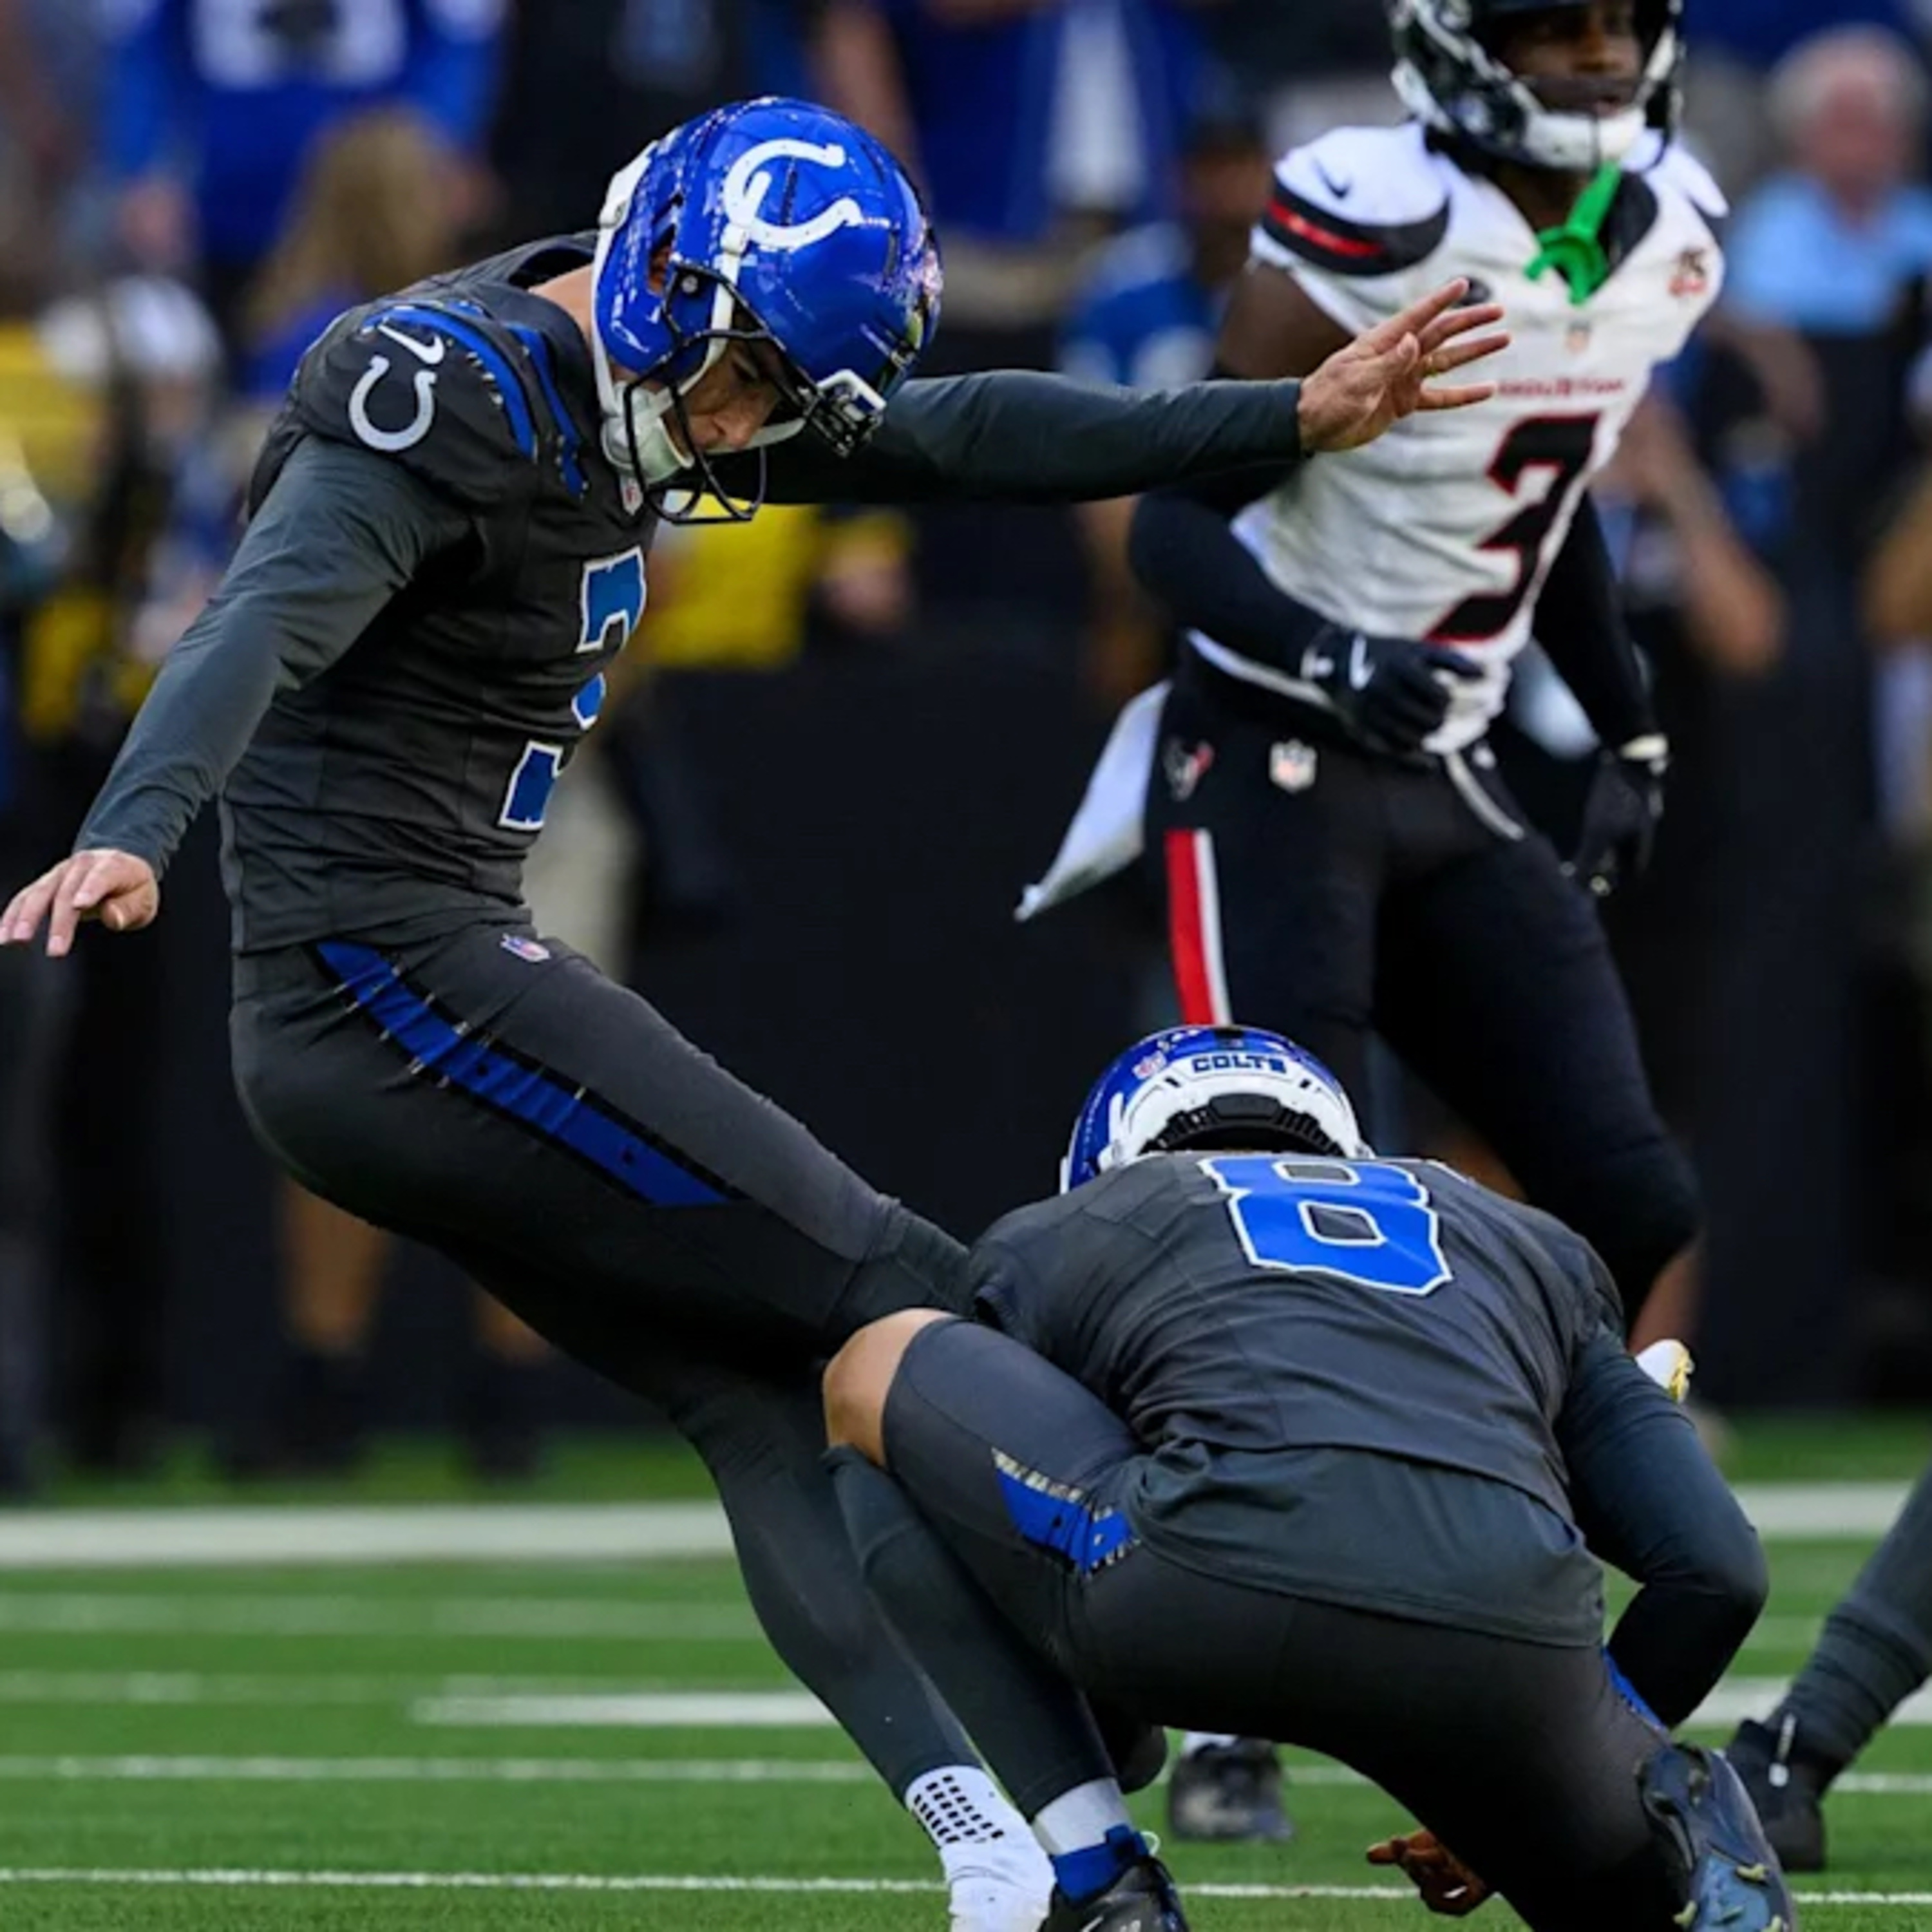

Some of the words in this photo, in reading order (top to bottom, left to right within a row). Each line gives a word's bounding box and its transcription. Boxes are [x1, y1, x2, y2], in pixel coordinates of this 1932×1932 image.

[1422, 410, 1604, 644] 3
[1192, 1054, 1287, 1074] COLTS
[1197, 1157, 1453, 1296] 8
